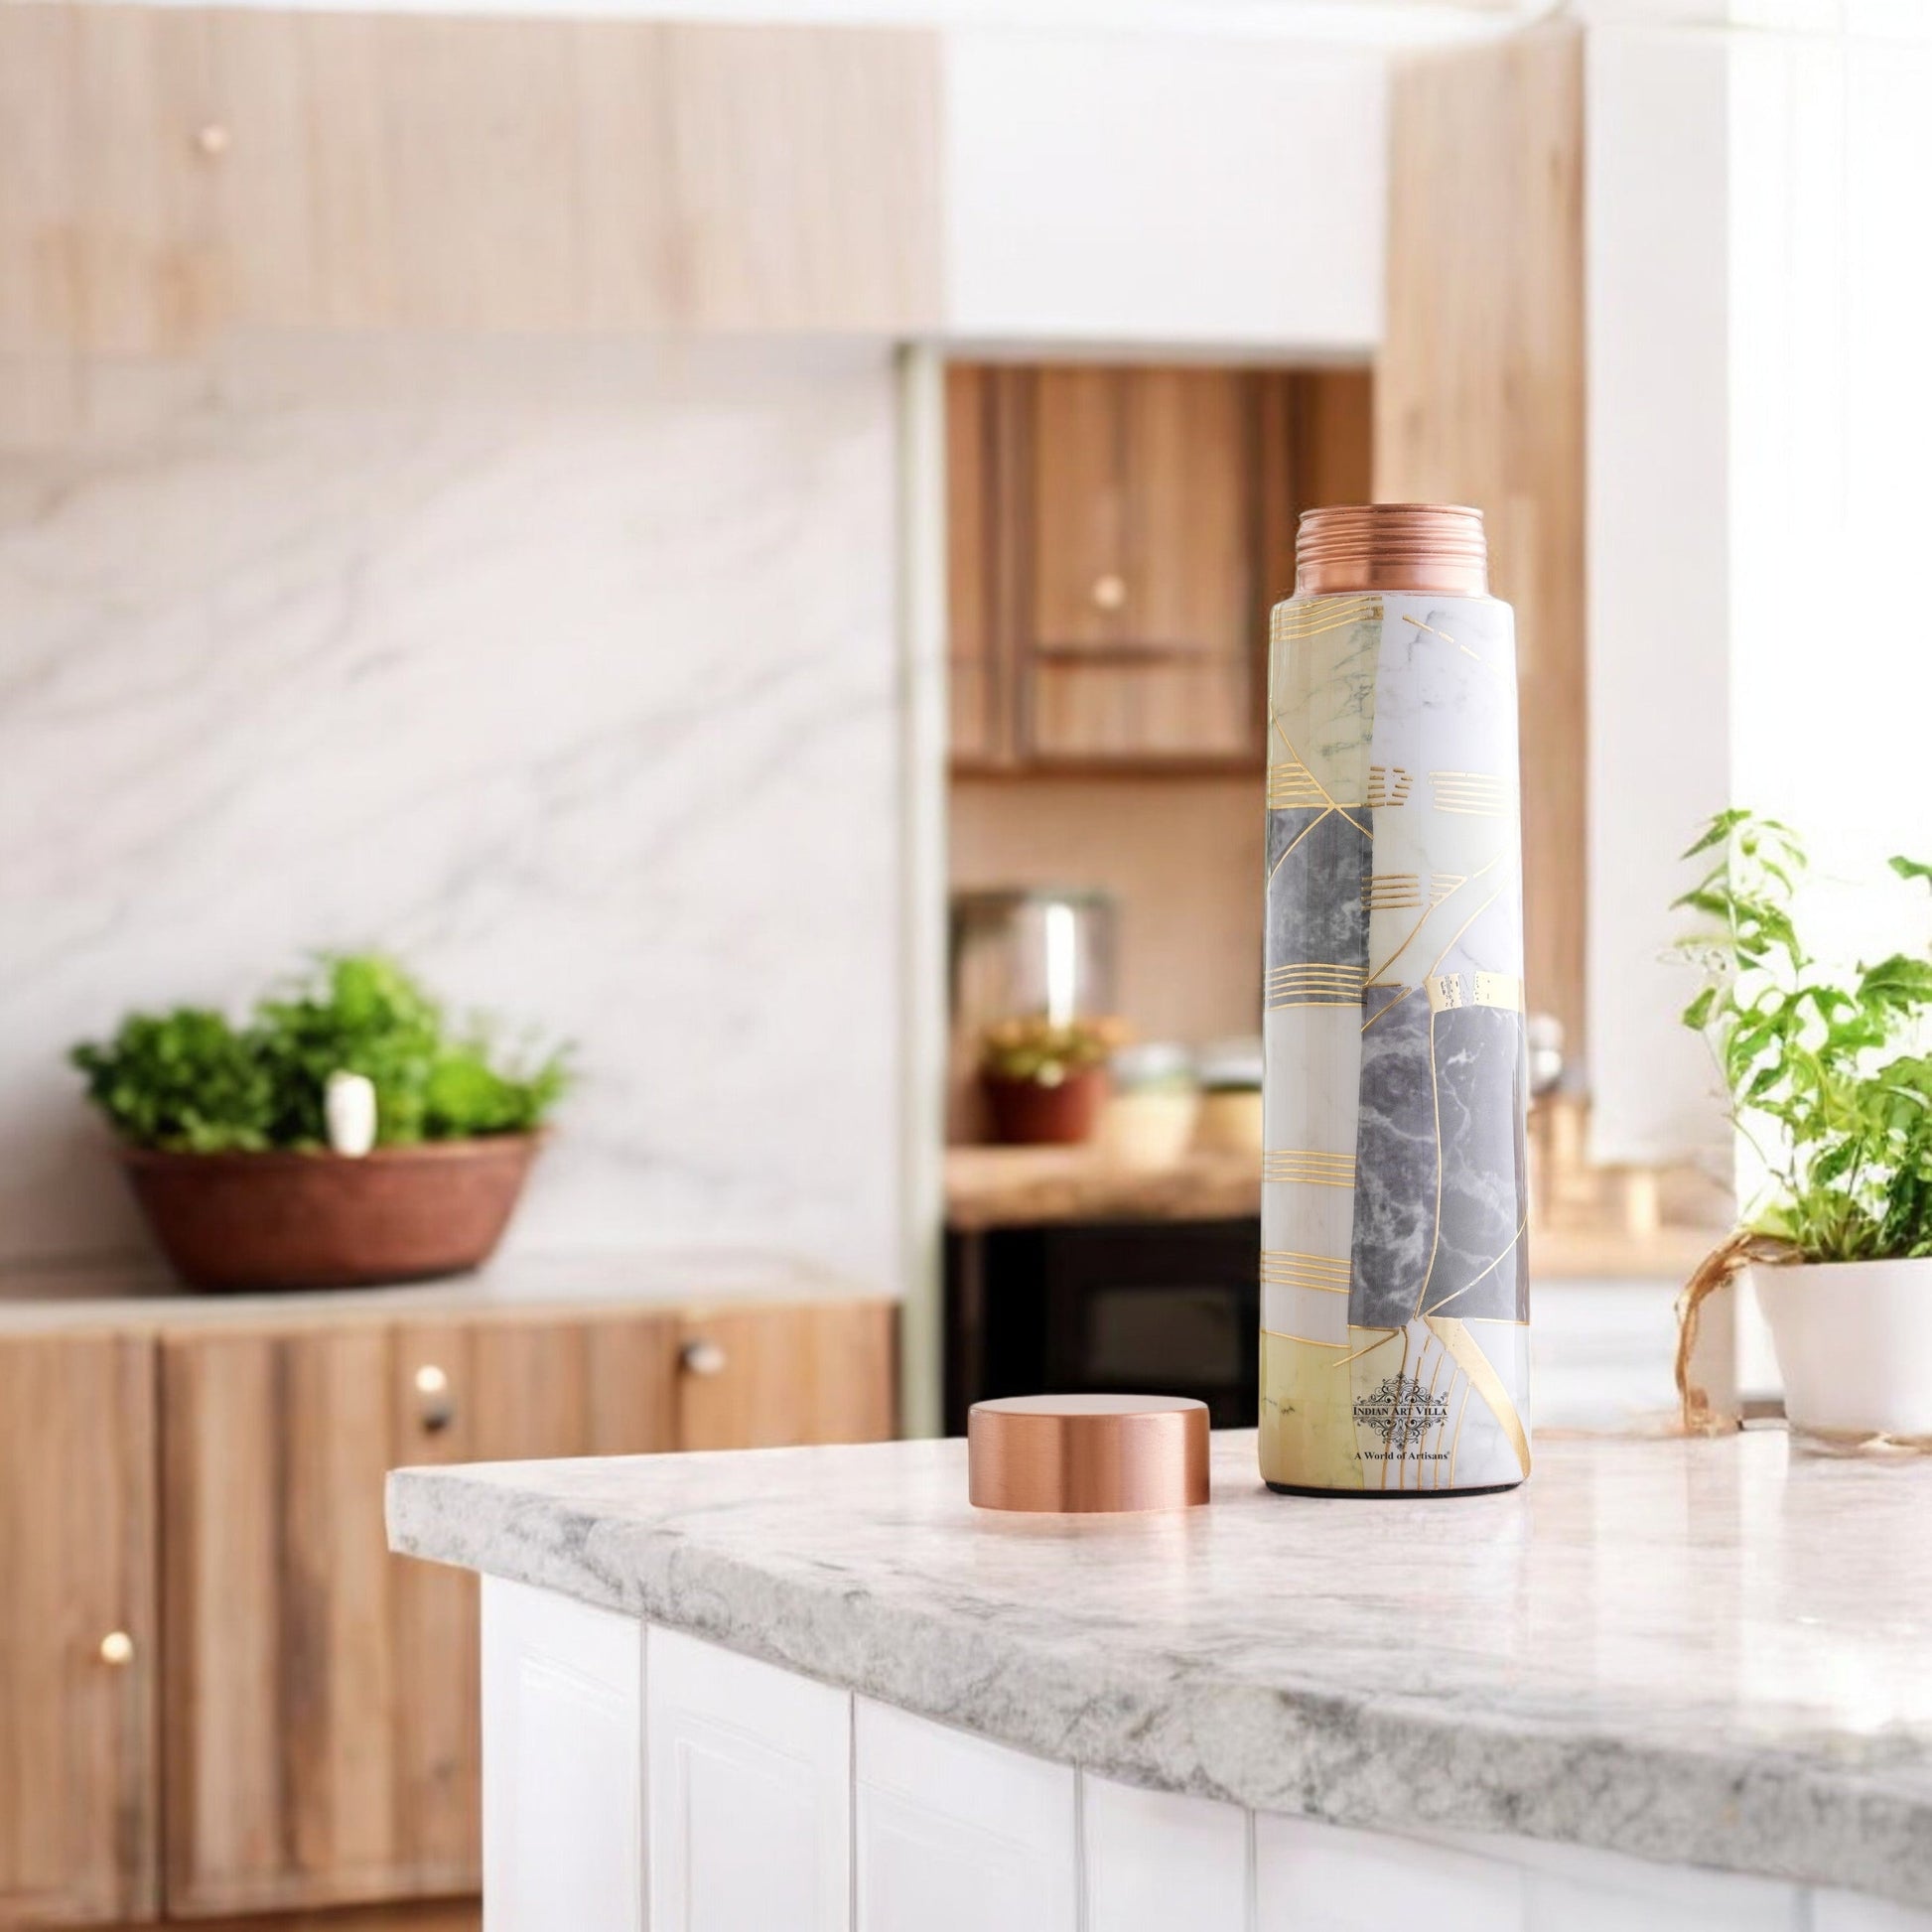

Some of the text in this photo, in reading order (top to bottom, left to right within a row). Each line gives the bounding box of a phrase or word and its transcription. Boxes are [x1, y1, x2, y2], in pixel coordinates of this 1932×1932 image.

[1353, 1406, 1448, 1416] INDIAN ART VILLA
[1364, 1451, 1394, 1460] World
[1396, 1451, 1407, 1460] of
